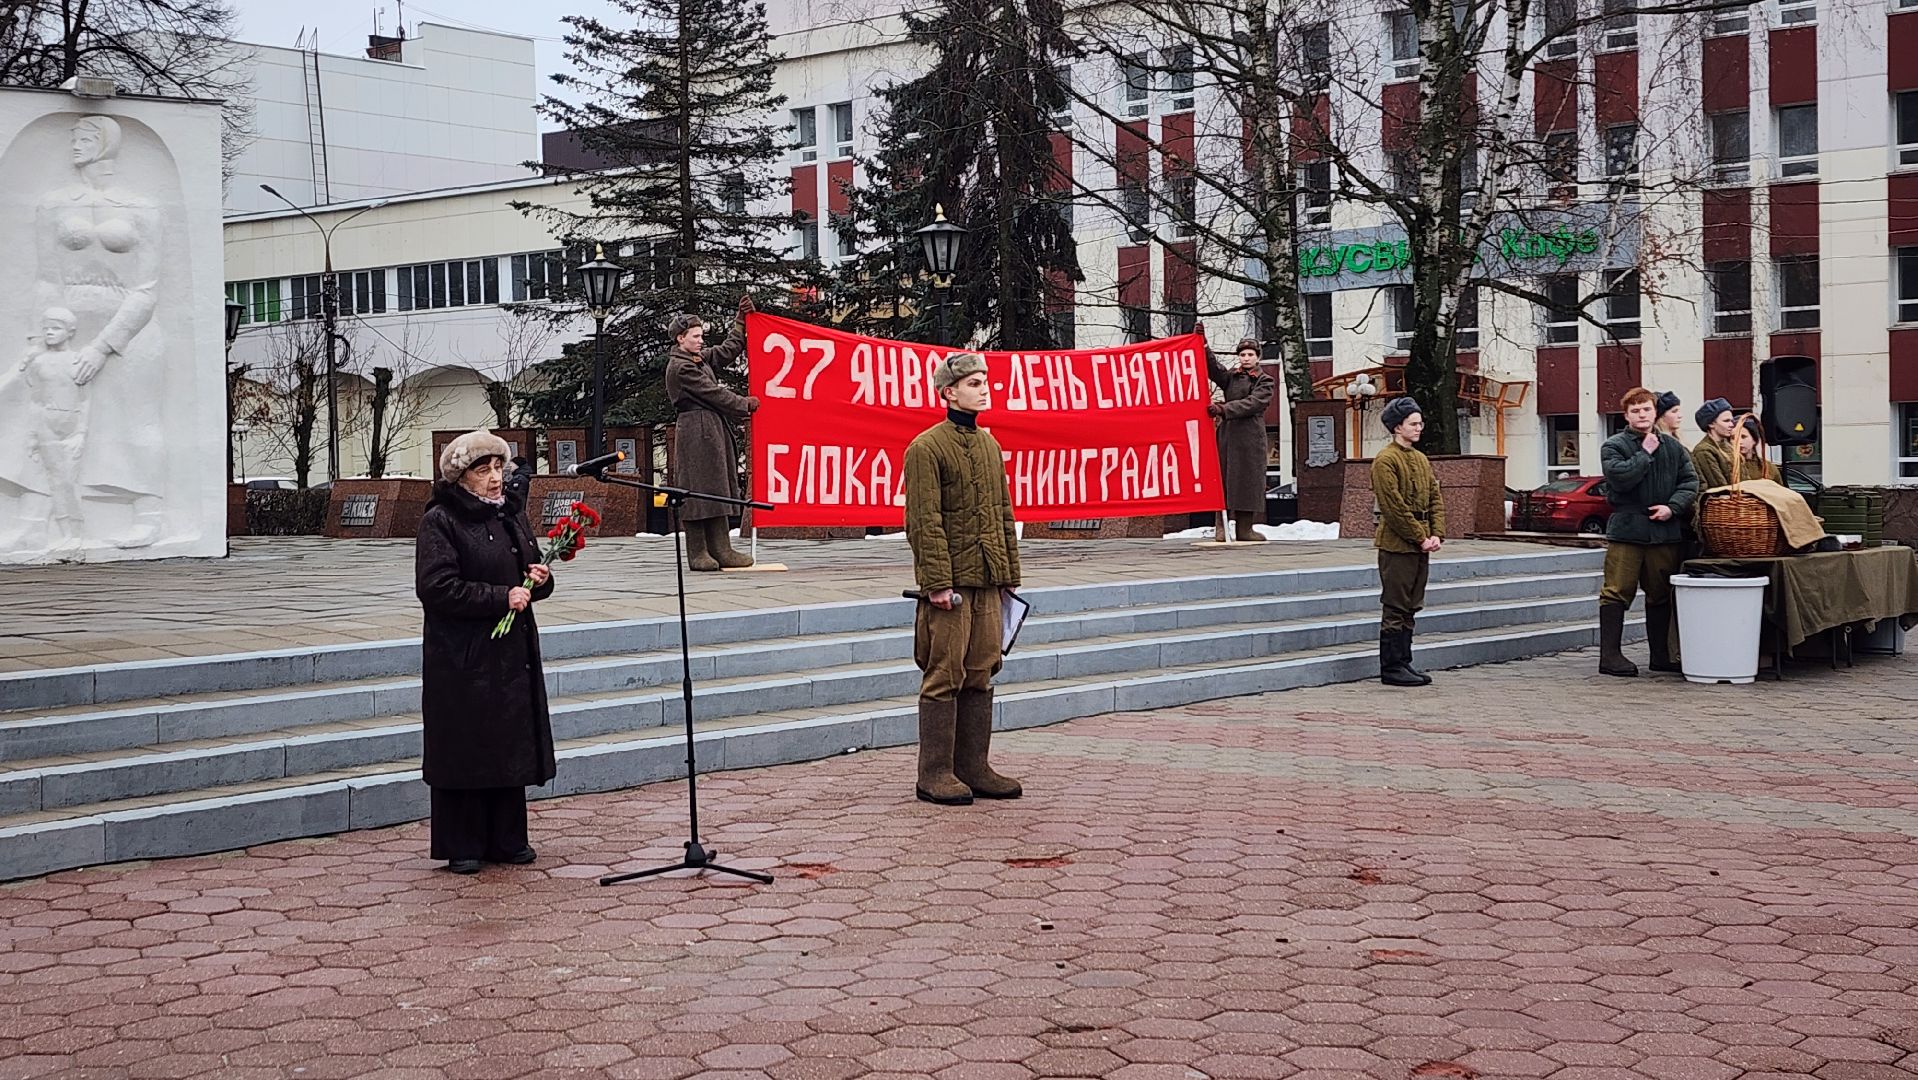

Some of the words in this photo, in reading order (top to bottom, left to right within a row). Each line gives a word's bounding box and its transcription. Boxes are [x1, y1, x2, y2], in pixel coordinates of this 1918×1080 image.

[762, 332, 836, 400] 27
[850, 342, 993, 411] ЯНВА
[1006, 353, 1088, 411] ДЕНЬ
[1091, 348, 1200, 410] СНЯТИЯ
[766, 444, 906, 507] БЛОКА
[350, 501, 376, 517] КИЕВ
